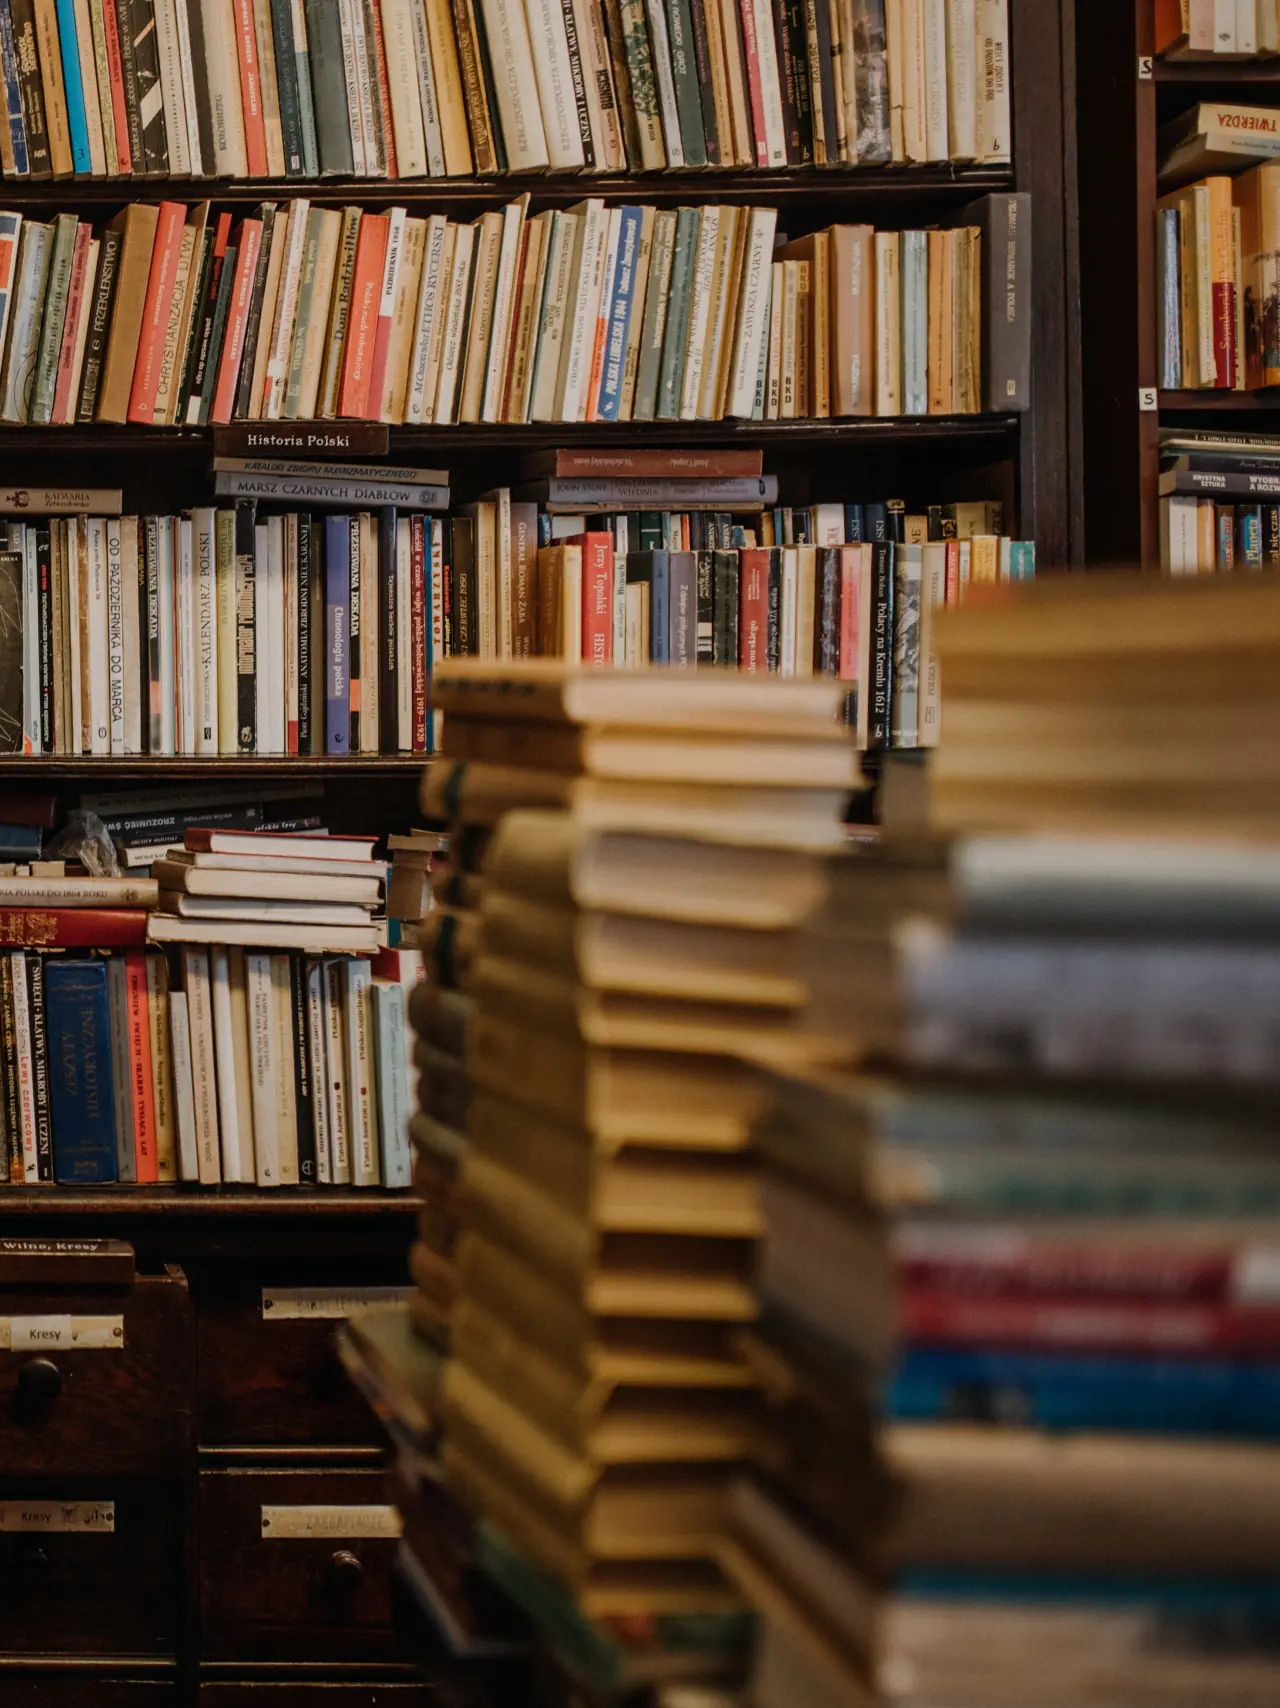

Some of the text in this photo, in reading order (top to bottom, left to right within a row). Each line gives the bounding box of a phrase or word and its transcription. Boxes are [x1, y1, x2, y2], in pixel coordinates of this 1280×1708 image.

[120, 35, 131, 59] Polsce
[672, 7, 683, 46] ROWECKI
[503, 28, 528, 152] RZECZPOSPOLITA OBOJGA
[545, 28, 571, 151] RZECZPOSPOLITA OBOJGA
[571, 56, 584, 97] MIKROBY
[579, 108, 590, 142] UCZENI
[596, 69, 613, 110] BUNSCH
[1217, 114, 1277, 132] TWIERDZA
[176, 231, 193, 271] LITWY
[335, 215, 358, 341] Dom Radziwiłłów
[422, 226, 443, 333] ETHOS RYCERSKI
[744, 243, 763, 338] ZAWISZA CZARNY
[157, 280, 185, 395] CHRYSTIANIZACJA
[360, 311, 369, 330] ruch
[606, 300, 627, 395] POLSKA LUBELSKA 1944
[248, 434, 350, 447] Historia Polski
[238, 481, 348, 497] MARSZ CZARNYCH
[244, 462, 417, 479] KATALOG ZBIORU NUMIZMATYCZNEGO
[1193, 474, 1226, 482] KRYSTYNA
[413, 523, 422, 552] Kościół
[1248, 518, 1258, 561] Planeta
[148, 524, 158, 639] PRZERWANA DEKADA
[199, 532, 212, 665] KALENDARZ POLSKI
[350, 521, 360, 636] PRZERWANA DEKADA
[518, 565, 526, 598] ROMAN
[593, 544, 607, 616] Jerzy Topolski
[617, 564, 625, 595] Bunsch
[414, 589, 423, 614] wojny
[459, 572, 468, 642] CZERWIEC 1956
[874, 603, 887, 634] Polacy
[108, 538, 122, 722] OD DO MARCA
[300, 524, 310, 738] Piotr ANATOMIA ZBRODNI NIEUKARANEJ
[332, 606, 344, 696] Chronologia polska
[877, 637, 884, 649] na
[414, 616, 424, 693] polsko-bolszewickiej
[876, 652, 886, 687] Kremlu
[876, 691, 884, 714] 1612
[15, 889, 45, 897] POLSKI
[83, 890, 108, 898] ROKU
[4, 1004, 16, 1096] ZAMEK CZOCHA HISTORIA
[61, 1032, 77, 1095] ZESZYTY
[80, 1006, 99, 1118] HISTORYCZNE
[17, 1008, 33, 1152] Piotr Lewy czerwcowy
[37, 1059, 47, 1106] MIKROBY
[330, 1009, 345, 1163] Paweł Jasienica Polska
[357, 1031, 371, 1168] Paweł Jasienica Polska
[40, 1116, 50, 1155] UCZENI
[3, 1242, 51, 1250] Wilno,
[56, 1242, 99, 1251] Kresy
[30, 1329, 61, 1341] Kresy
[21, 1510, 51, 1523] Kresy
